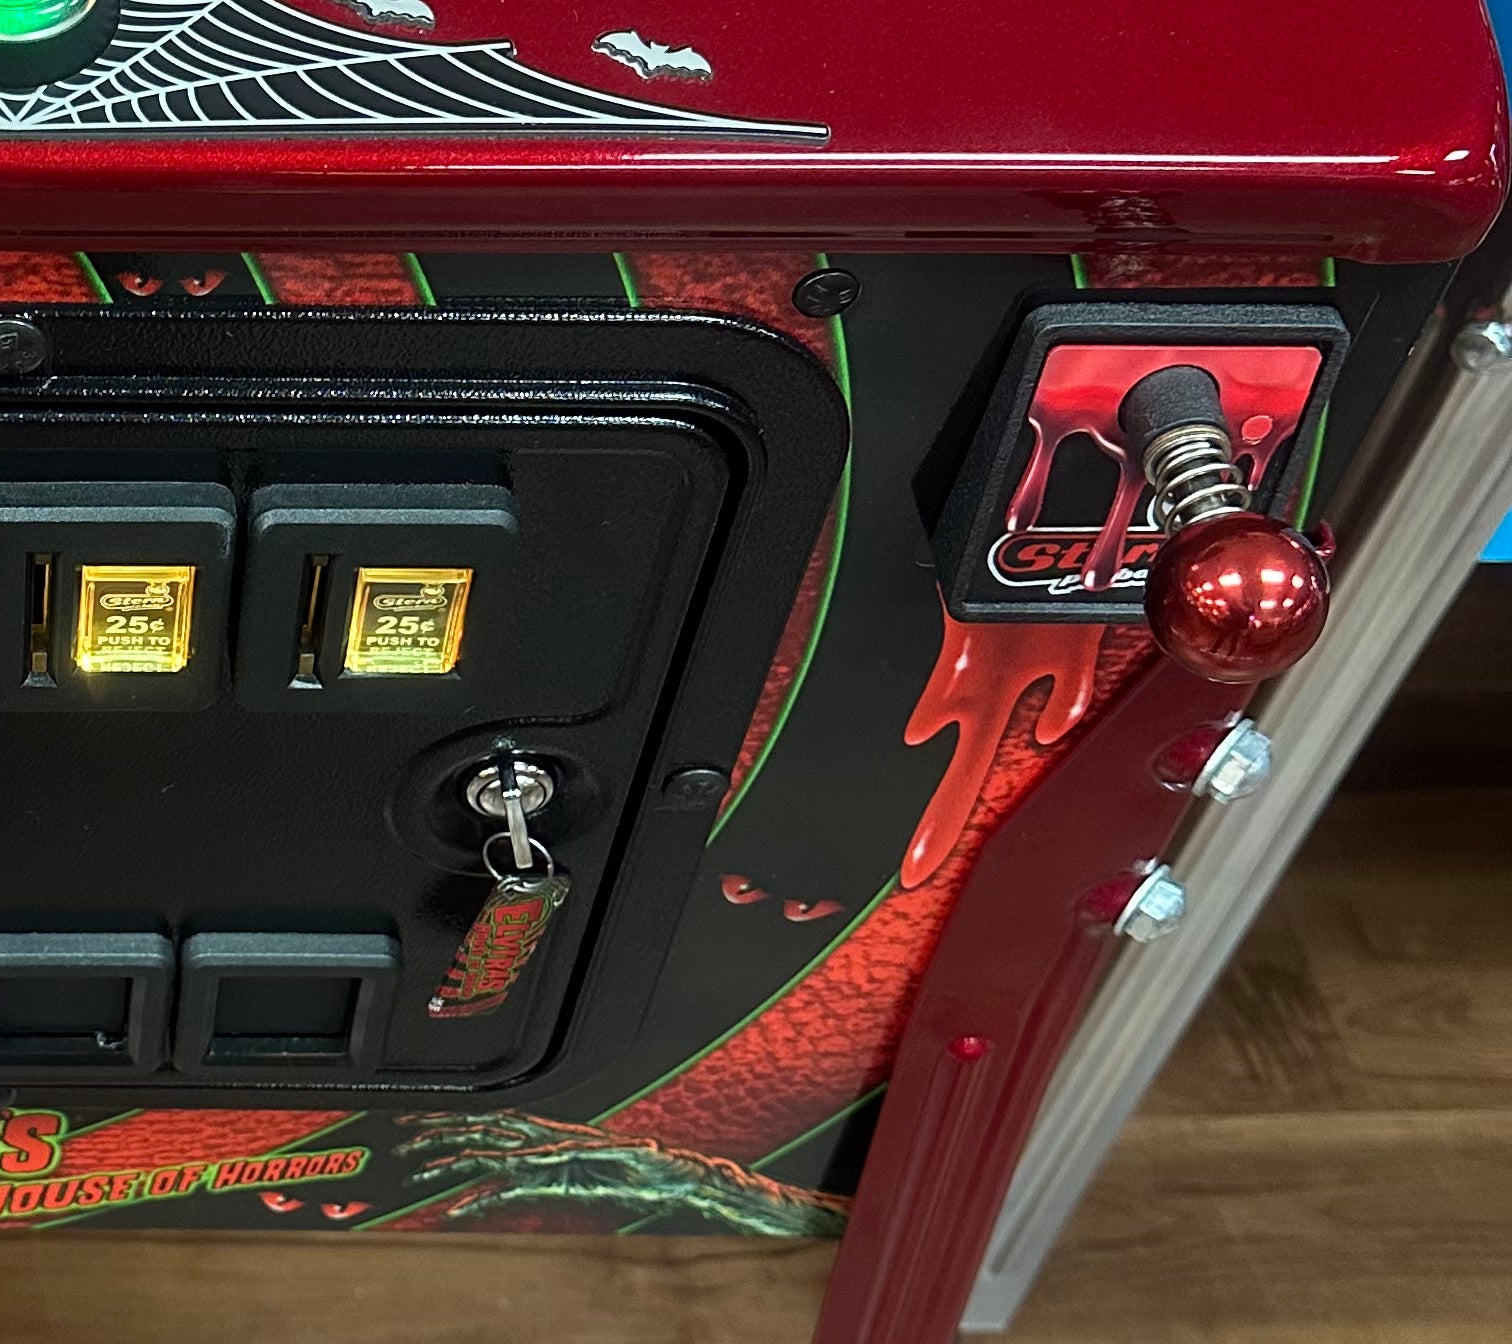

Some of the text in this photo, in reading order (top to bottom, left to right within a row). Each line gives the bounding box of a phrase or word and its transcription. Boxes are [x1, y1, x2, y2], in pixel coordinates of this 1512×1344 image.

[108, 596, 168, 606] Stern
[381, 597, 442, 606] Stern
[104, 615, 166, 634] 25¢
[374, 615, 436, 635] 25¢
[97, 636, 171, 646] PUSH TO
[365, 636, 440, 647] PUSH TO
[151, 1169, 207, 1197] OF
[215, 1149, 366, 1191] HORRORS
